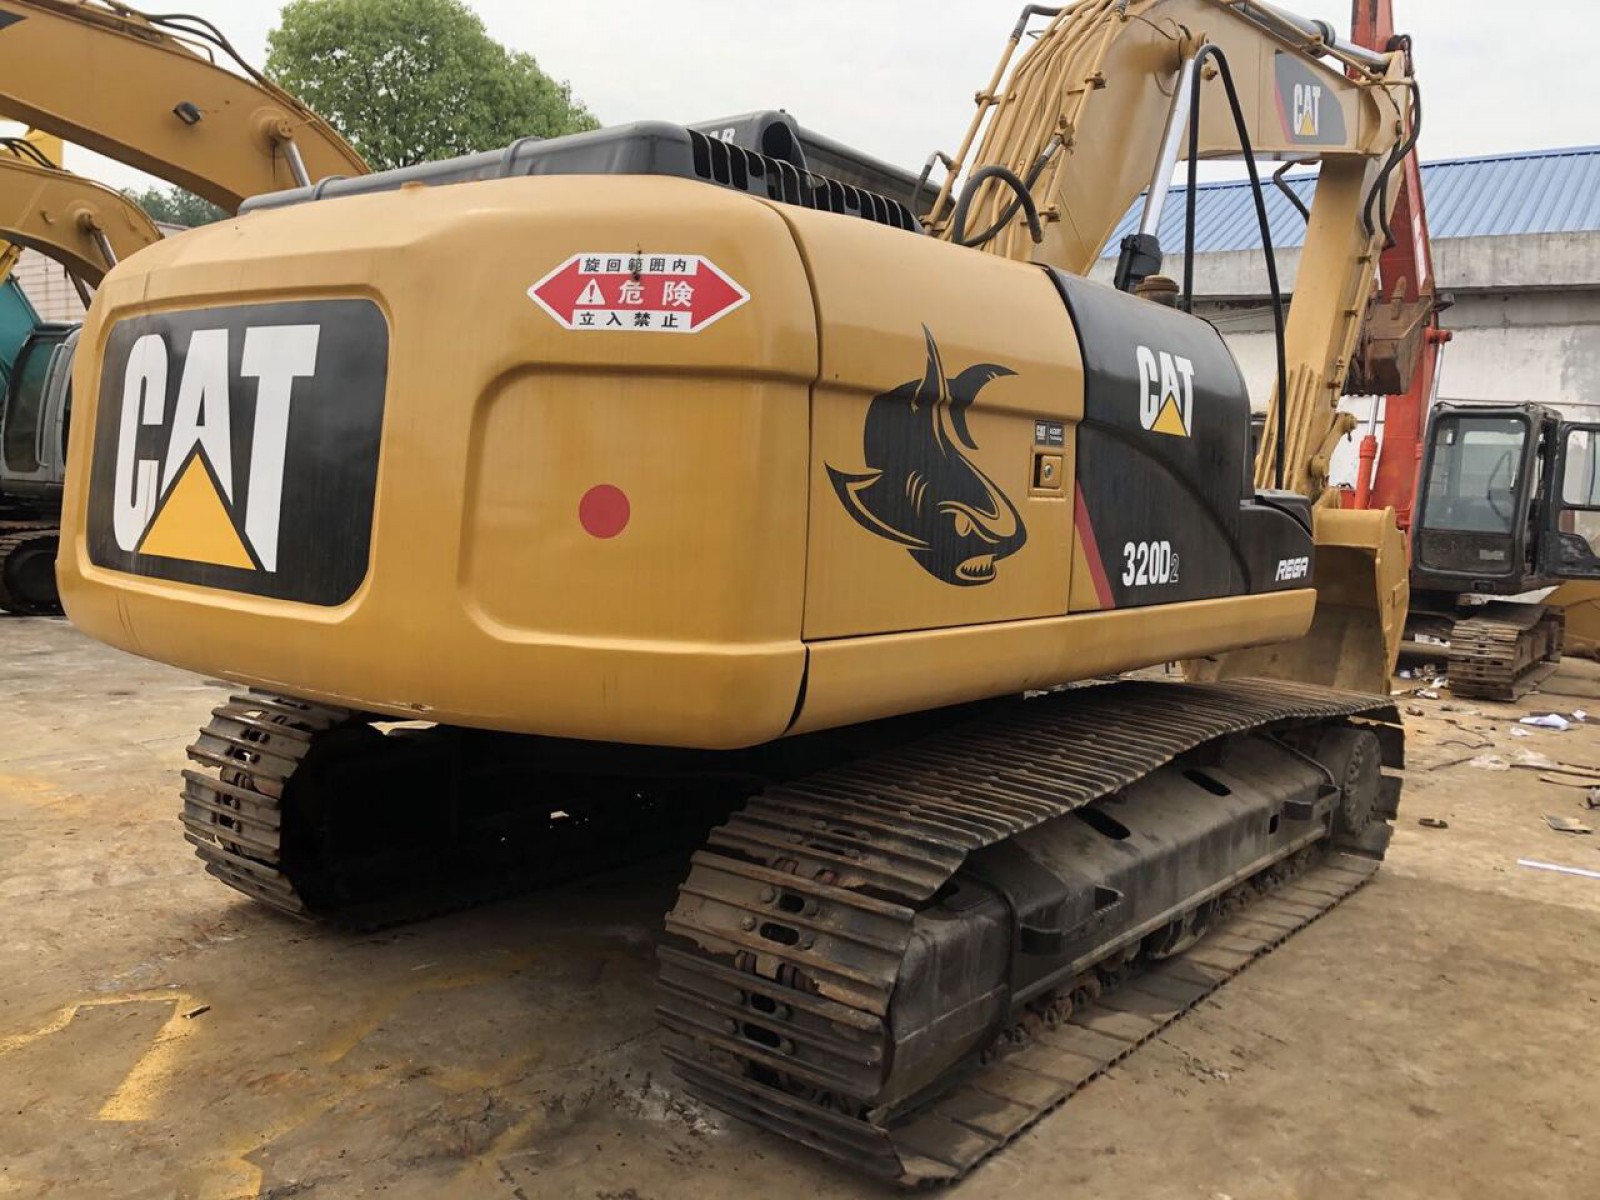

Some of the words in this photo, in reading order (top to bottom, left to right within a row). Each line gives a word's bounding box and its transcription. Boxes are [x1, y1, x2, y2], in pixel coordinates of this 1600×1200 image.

[1293, 83, 1321, 136] CAT
[584, 257, 687, 273] 旋回範囲内
[617, 280, 696, 307] 危険
[578, 311, 679, 329] 立入禁止
[1135, 344, 1195, 438] CAT
[112, 324, 321, 573] CAT
[1274, 556, 1310, 582] REGA
